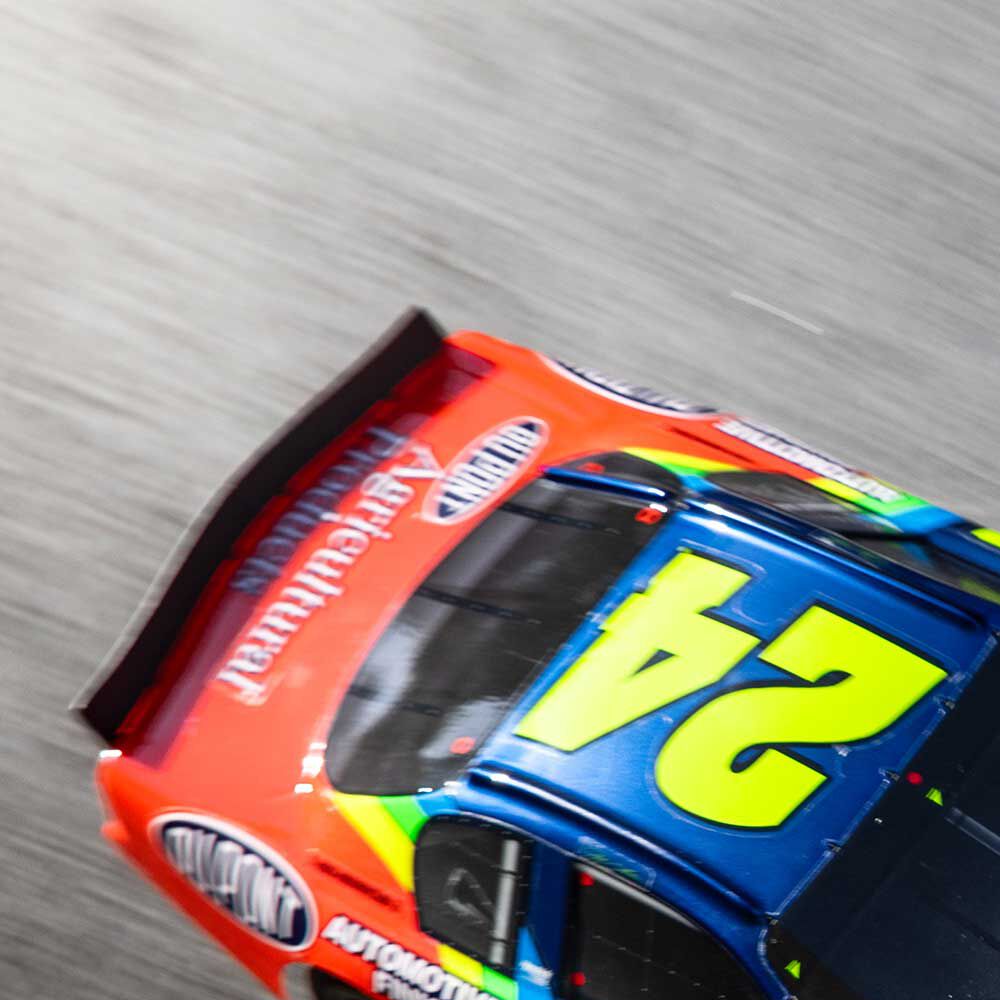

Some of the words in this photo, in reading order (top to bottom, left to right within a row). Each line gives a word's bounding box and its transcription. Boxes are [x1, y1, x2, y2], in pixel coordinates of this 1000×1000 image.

[440, 422, 541, 518] DUPONT
[215, 444, 446, 706] Agricultural
[513, 549, 949, 828] 24
[162, 825, 303, 940] DUPONT
